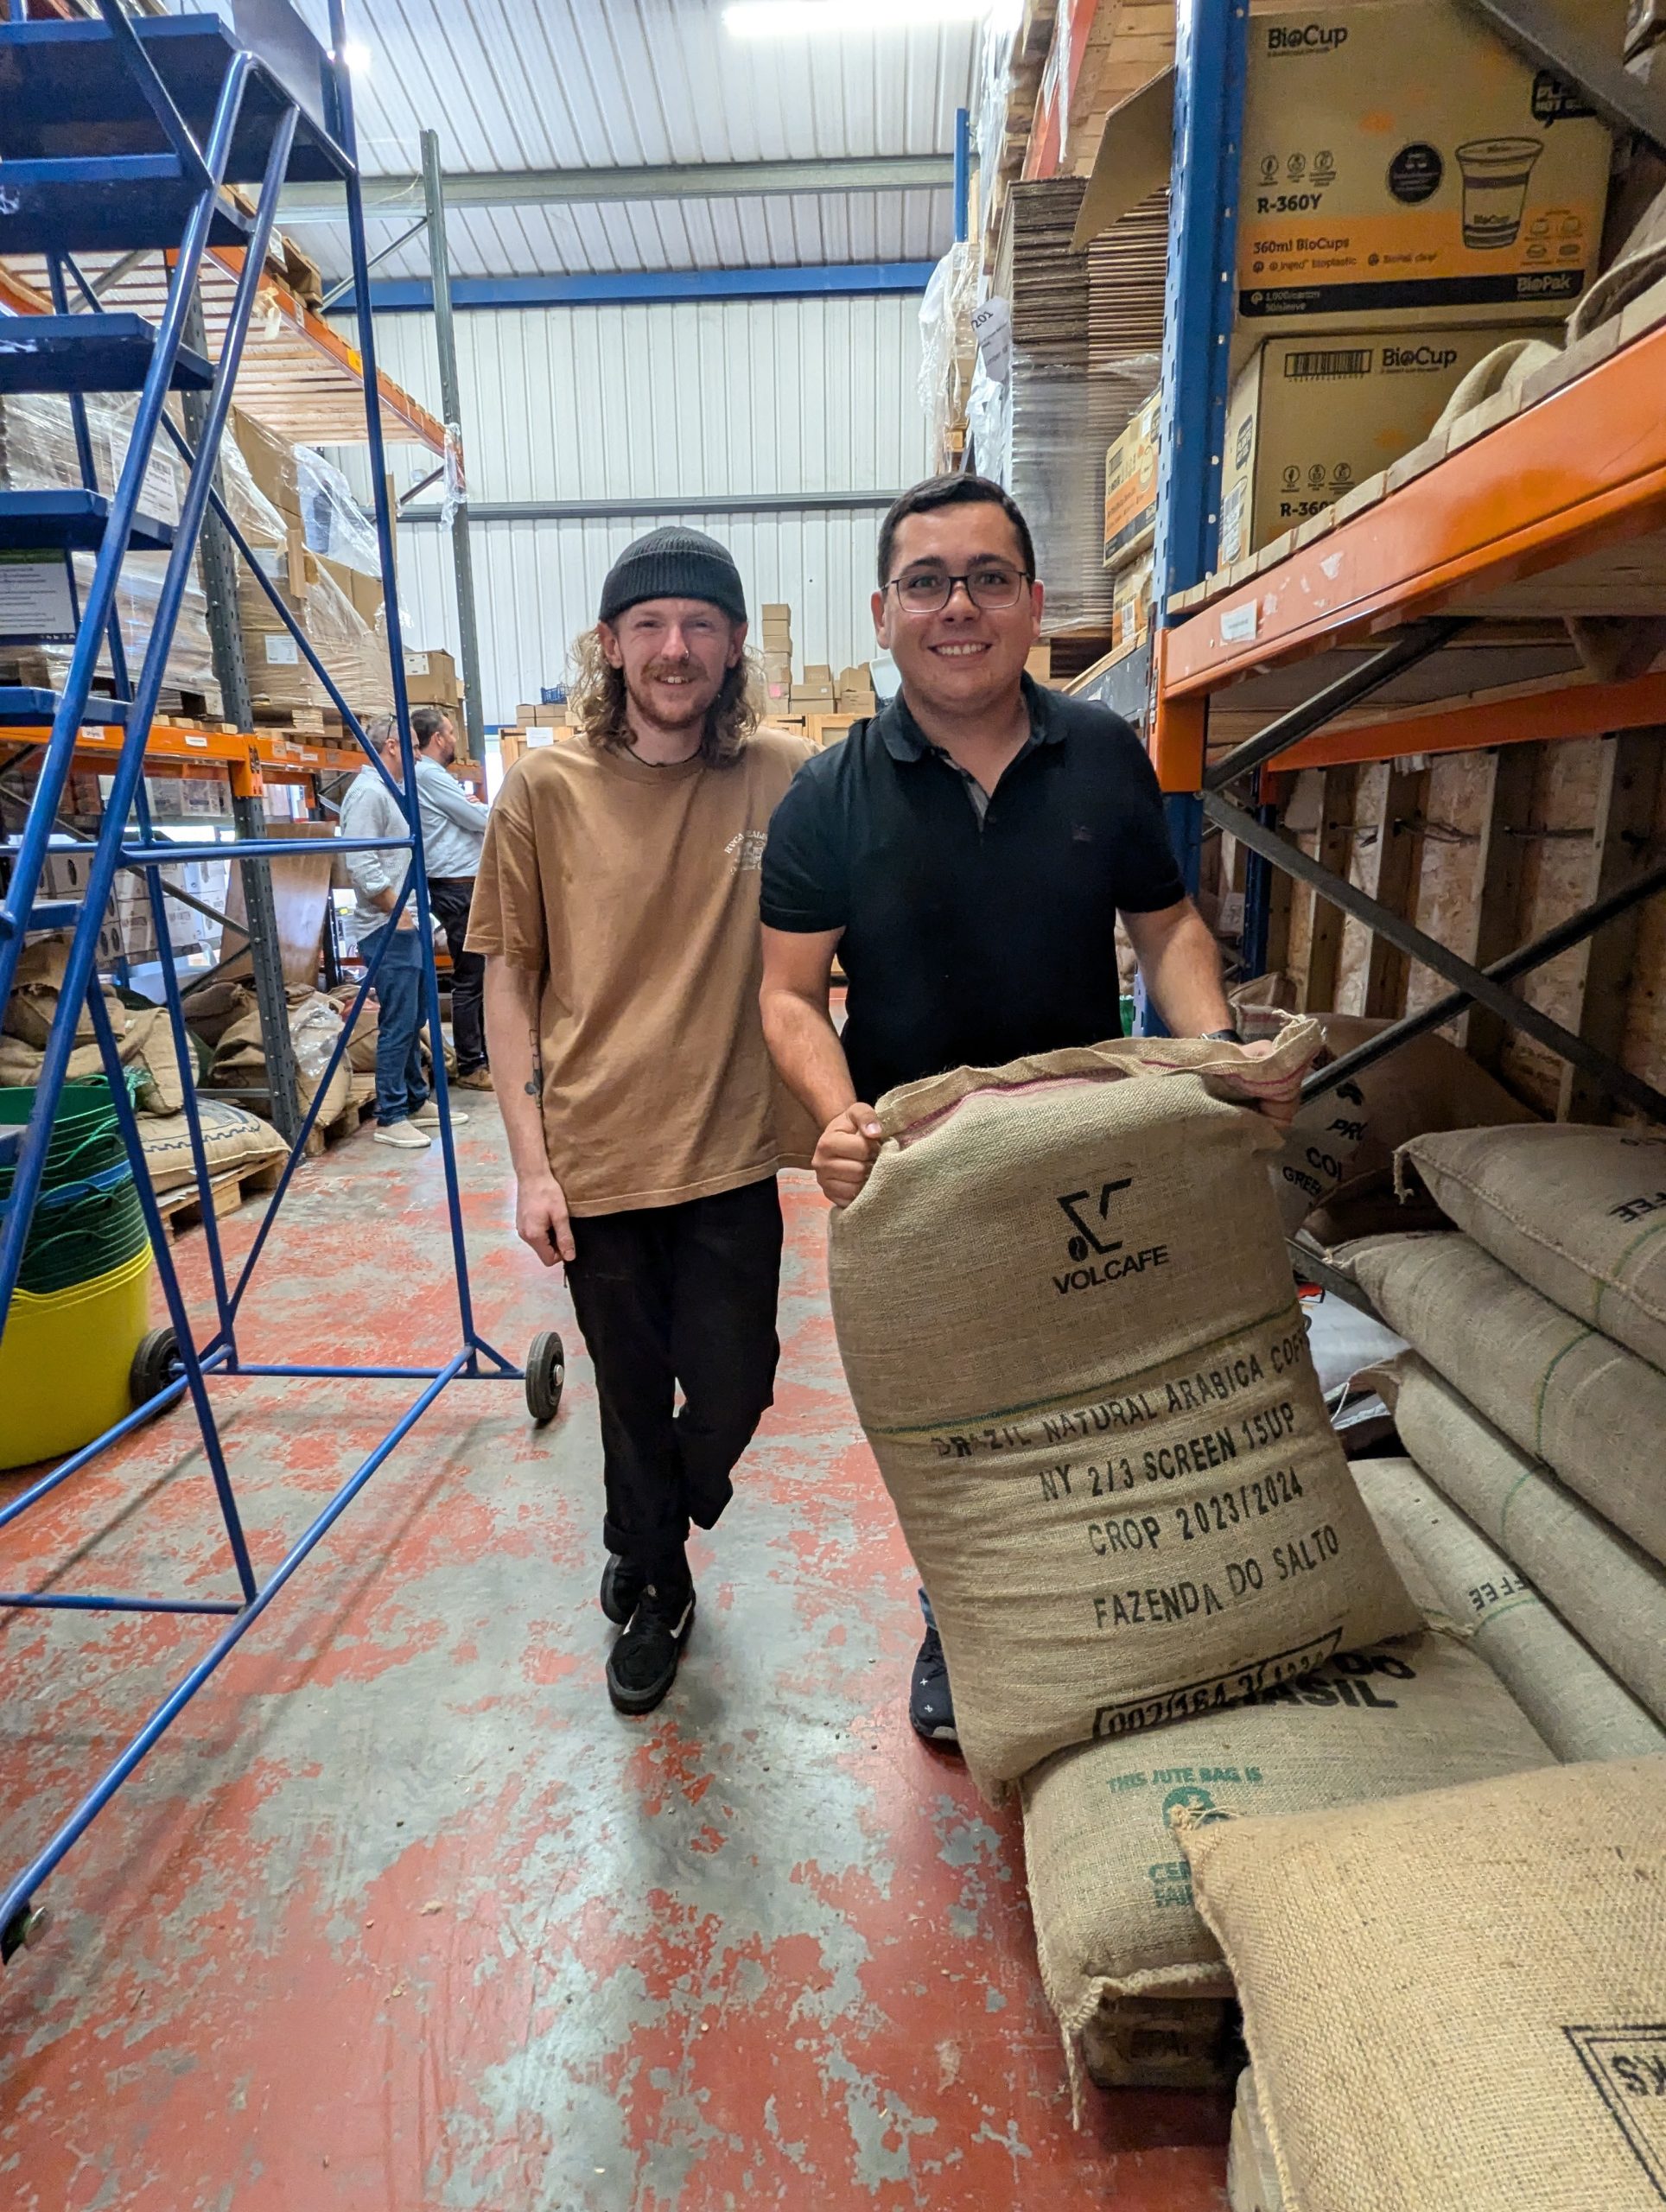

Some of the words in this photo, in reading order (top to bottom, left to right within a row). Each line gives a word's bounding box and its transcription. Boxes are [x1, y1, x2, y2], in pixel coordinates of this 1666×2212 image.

[1268, 24, 1348, 48] BioCup
[1256, 193, 1322, 213] R-360Y
[1252, 239, 1292, 254] 360ml
[1296, 237, 1350, 252] BioCups
[1517, 274, 1572, 292] BioPak
[1383, 346, 1457, 369] BioCup
[1281, 500, 1336, 518] R-360
[1052, 1243, 1169, 1294] VOLCAFE
[1041, 1393, 1159, 1444] NATURAL
[1165, 1354, 1264, 1414] ARABICA
[1039, 1464, 1072, 1502] NY
[1088, 1457, 1135, 1497] 2/3
[1143, 1427, 1237, 1483] SCREEN
[1241, 1402, 1295, 1450] 15UP
[1087, 1516, 1161, 1557] CROP
[1175, 1466, 1304, 1541] 2023/2024
[1092, 1581, 1224, 1630] FAZENDA
[1225, 1558, 1263, 1599] DO
[1272, 1524, 1340, 1580] SALTO
[1332, 1651, 1417, 1681] DO
[1106, 1771, 1148, 1794] THIS
[1151, 1767, 1197, 1785] JUTE
[1199, 1766, 1243, 1783] BAG
[1244, 1765, 1263, 1783] IS
